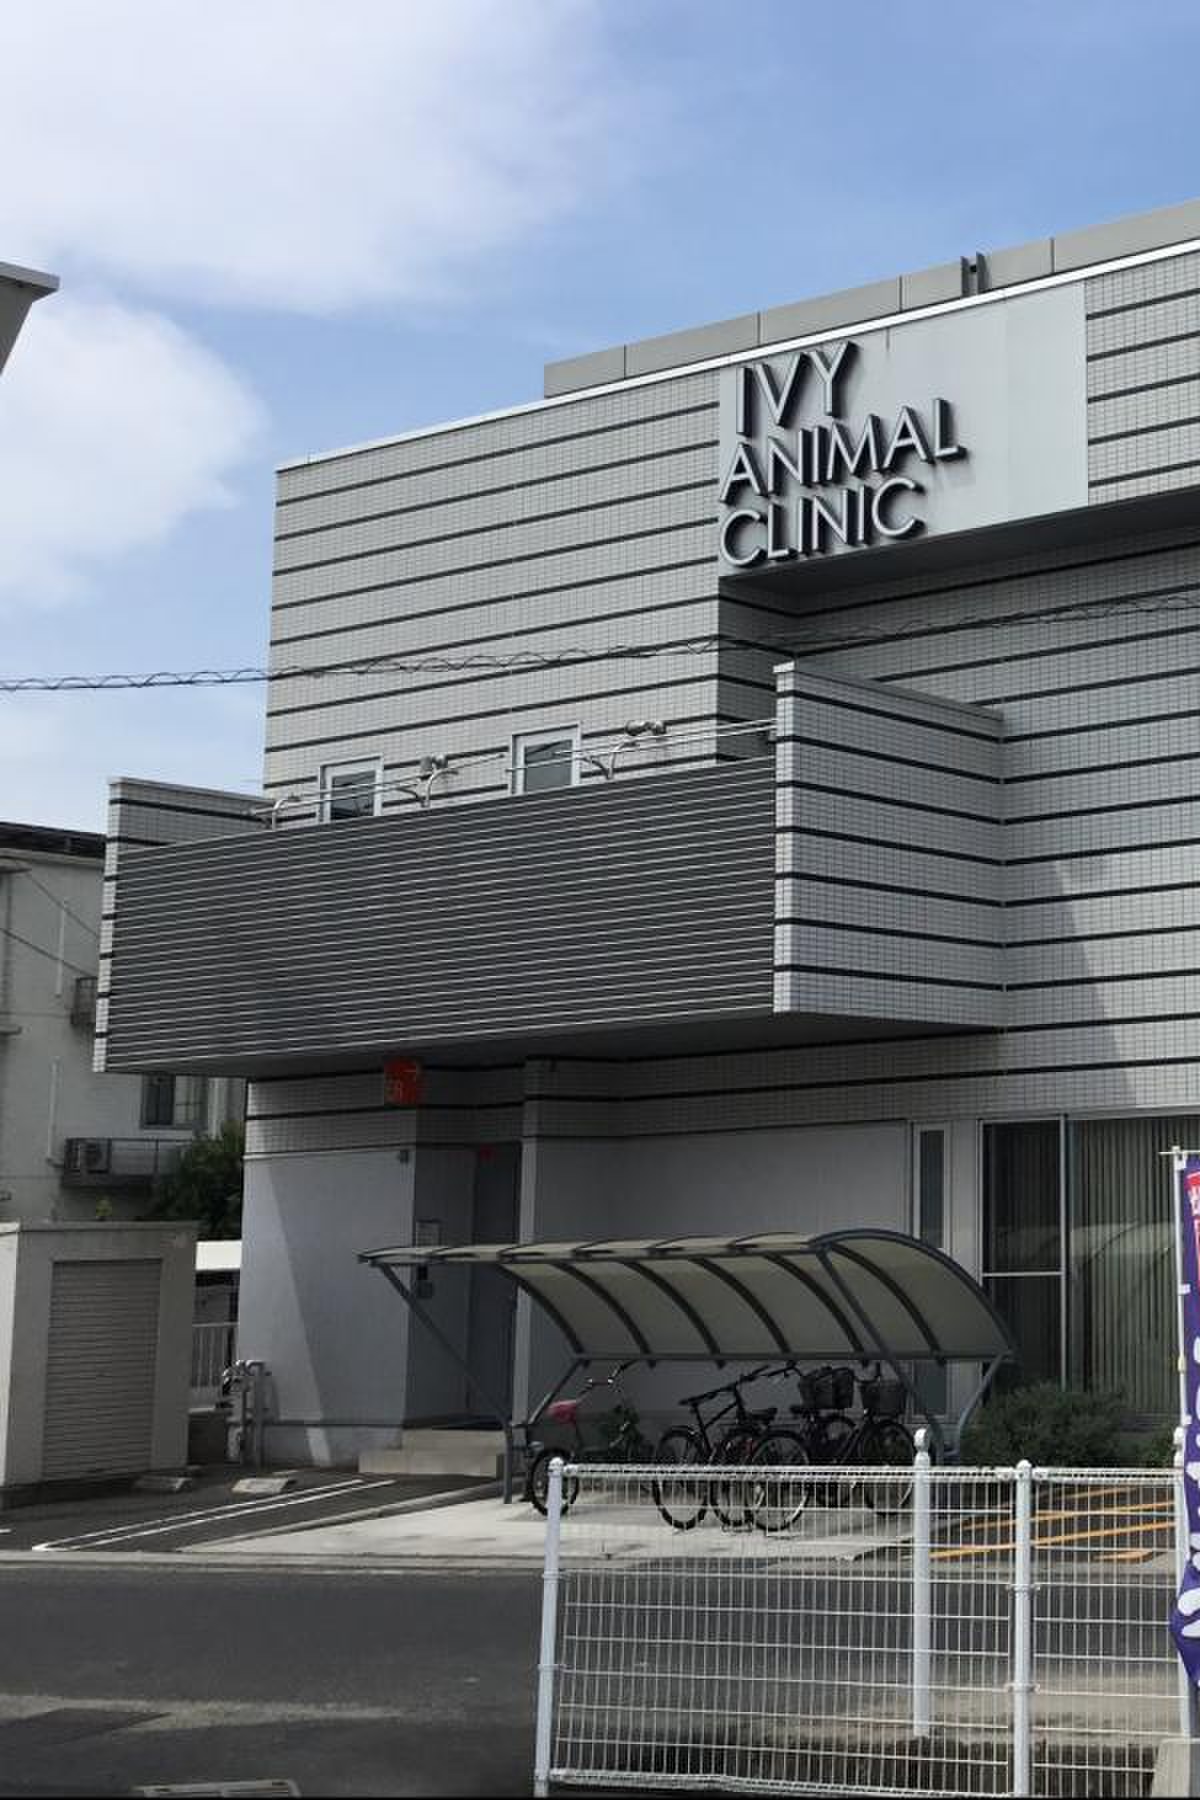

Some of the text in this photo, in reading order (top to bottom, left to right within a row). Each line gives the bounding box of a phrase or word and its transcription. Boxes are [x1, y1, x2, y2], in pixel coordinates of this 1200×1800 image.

[736, 340, 859, 437] IVY
[720, 398, 967, 505] ANIMAL
[720, 476, 926, 568] CLINIC
